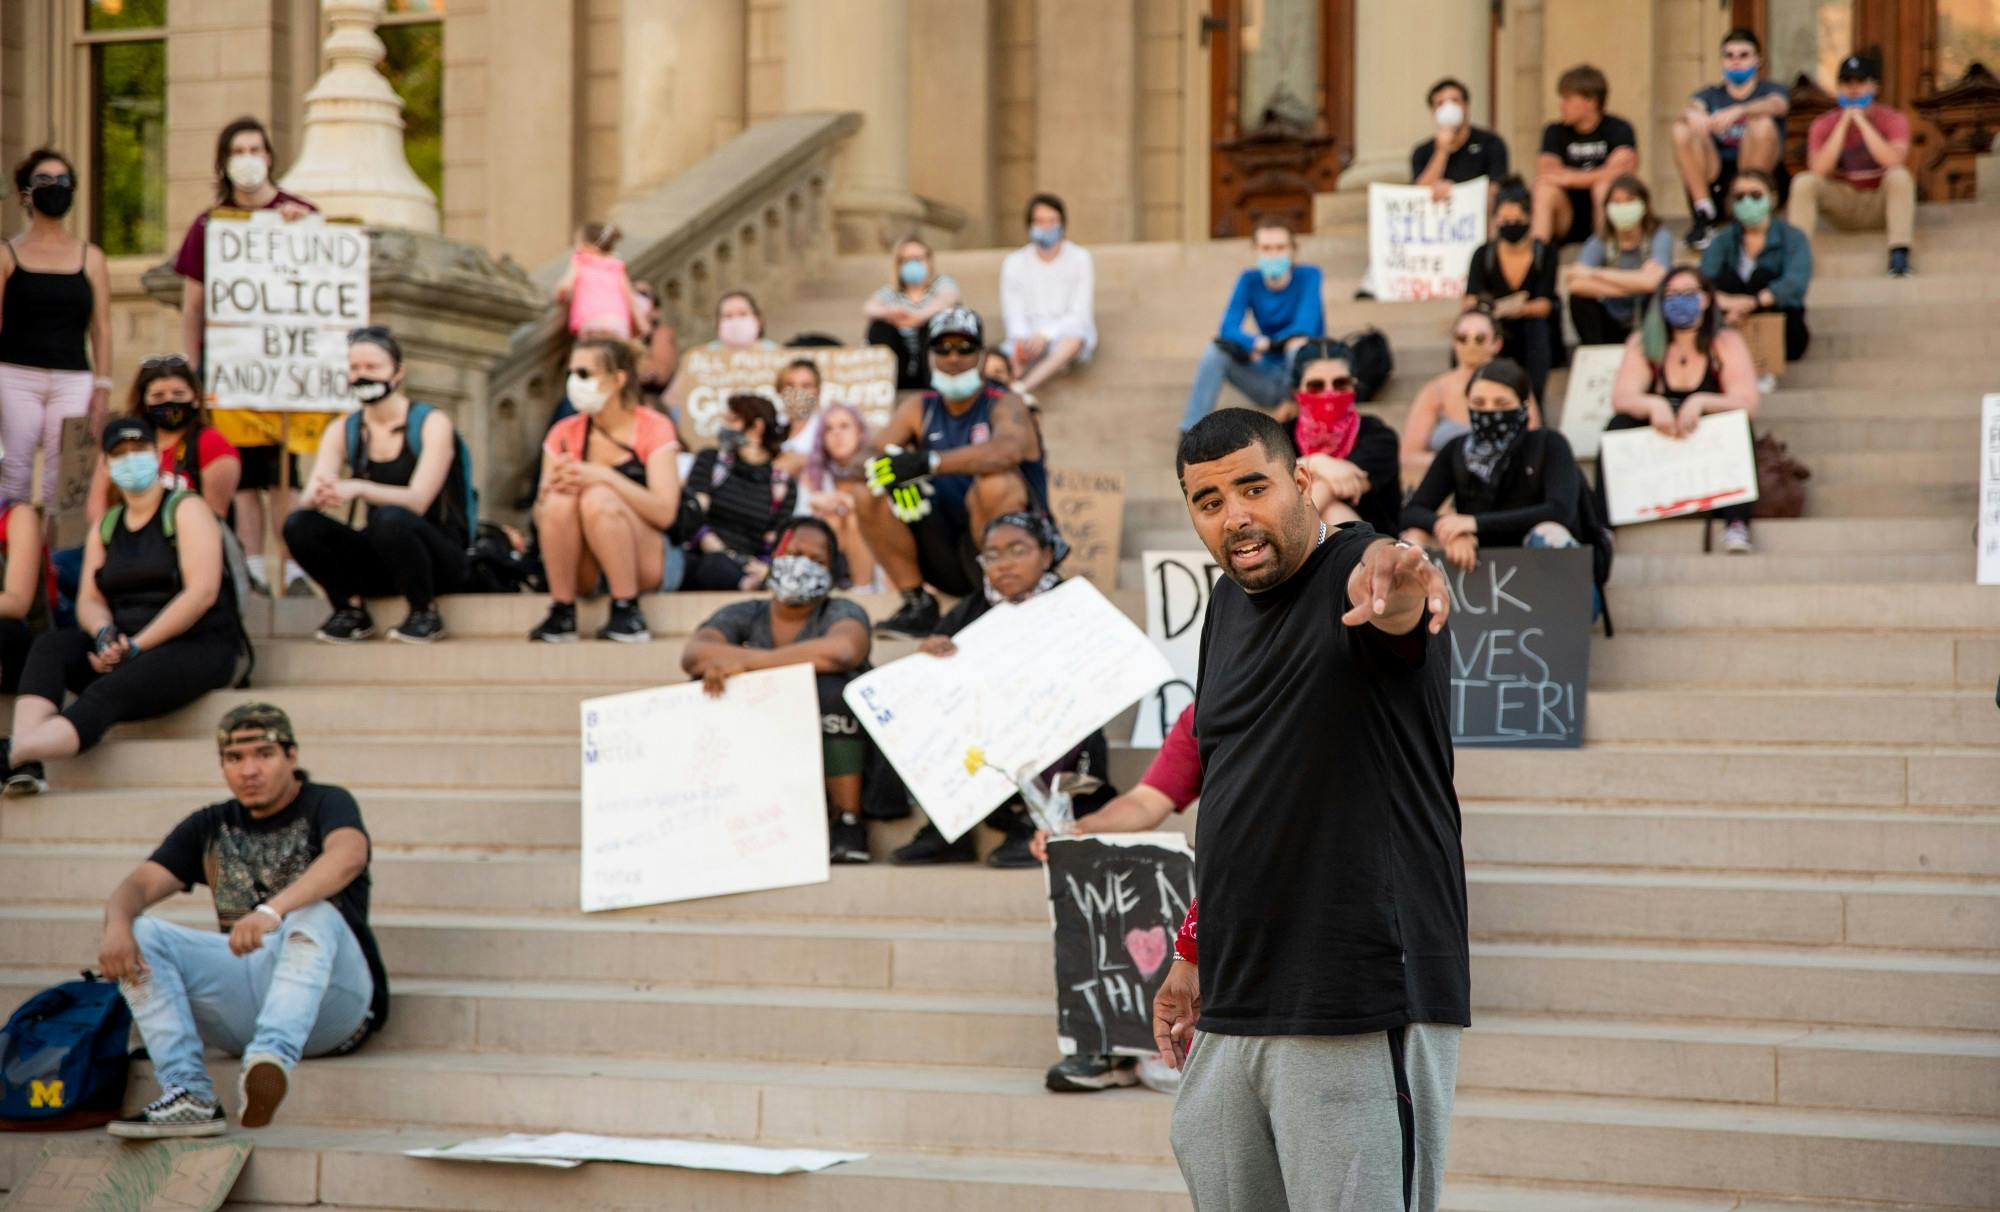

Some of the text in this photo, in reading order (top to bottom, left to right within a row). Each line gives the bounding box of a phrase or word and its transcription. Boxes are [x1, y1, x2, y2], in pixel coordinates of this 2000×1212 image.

[219, 229, 361, 268] DEFUND
[211, 278, 358, 318] POLICE
[263, 324, 318, 358] BYE
[212, 361, 281, 396] ANDY
[1066, 868, 1140, 919] WE
[30, 1079, 65, 1108] M
